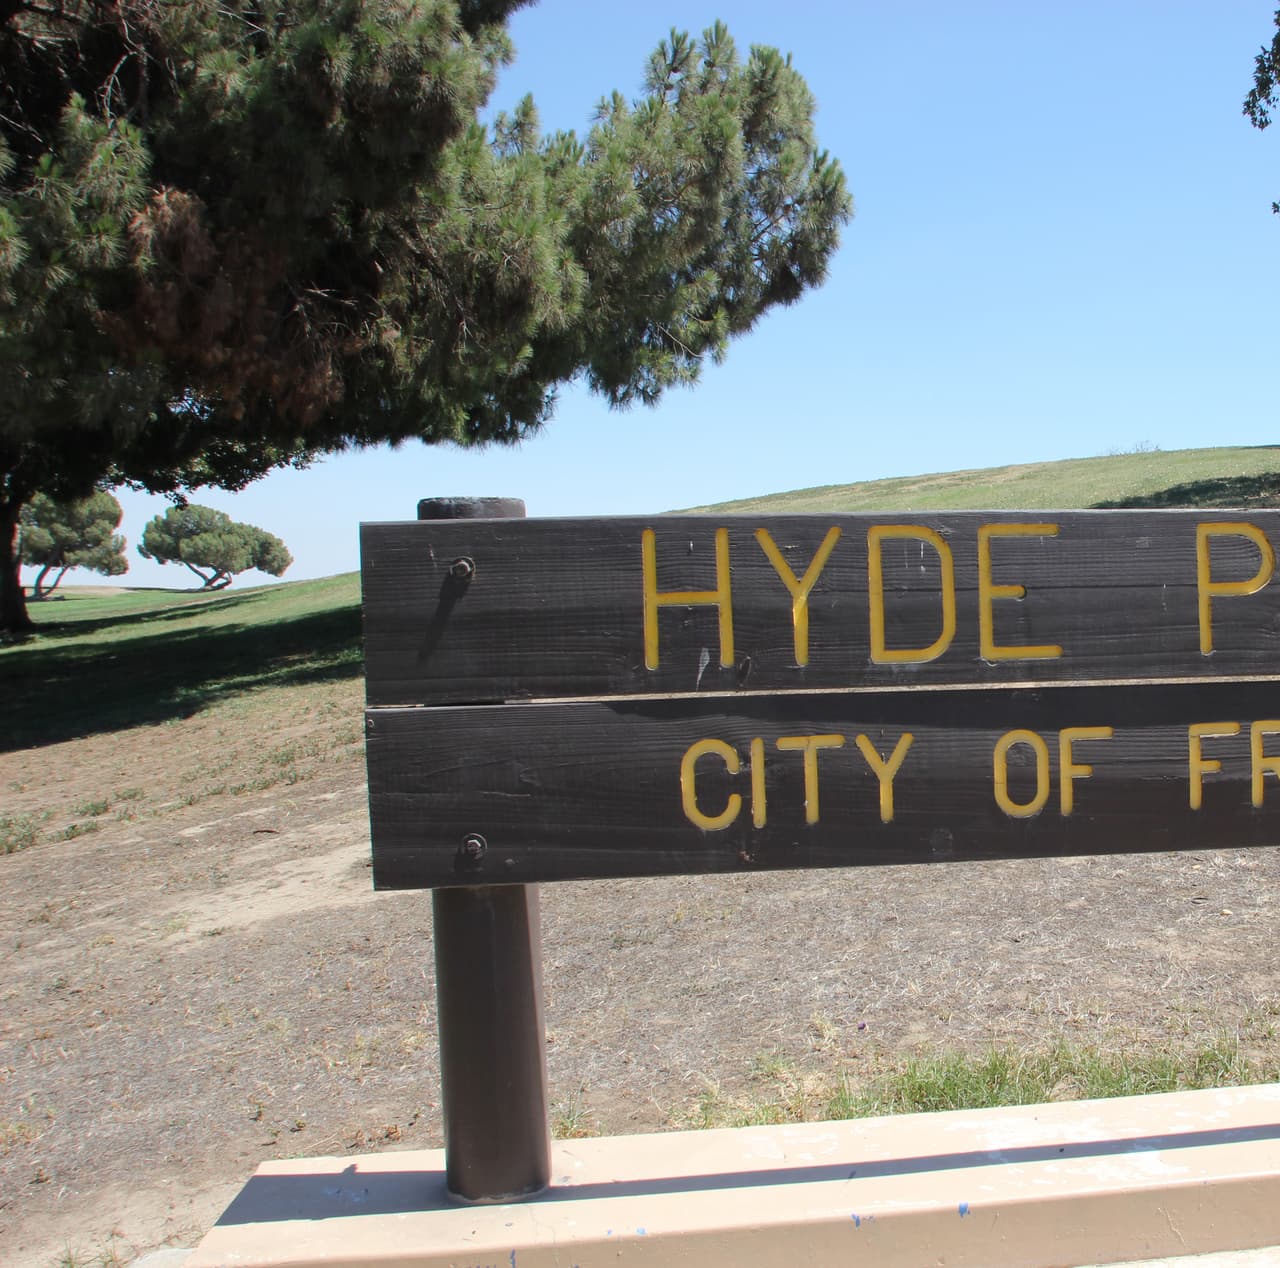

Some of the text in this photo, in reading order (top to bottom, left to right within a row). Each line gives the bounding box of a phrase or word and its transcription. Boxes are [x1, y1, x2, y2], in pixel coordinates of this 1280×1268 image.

[642, 523, 1064, 671] HYDE
[680, 731, 914, 830] CITY
[994, 725, 1114, 817] OF
